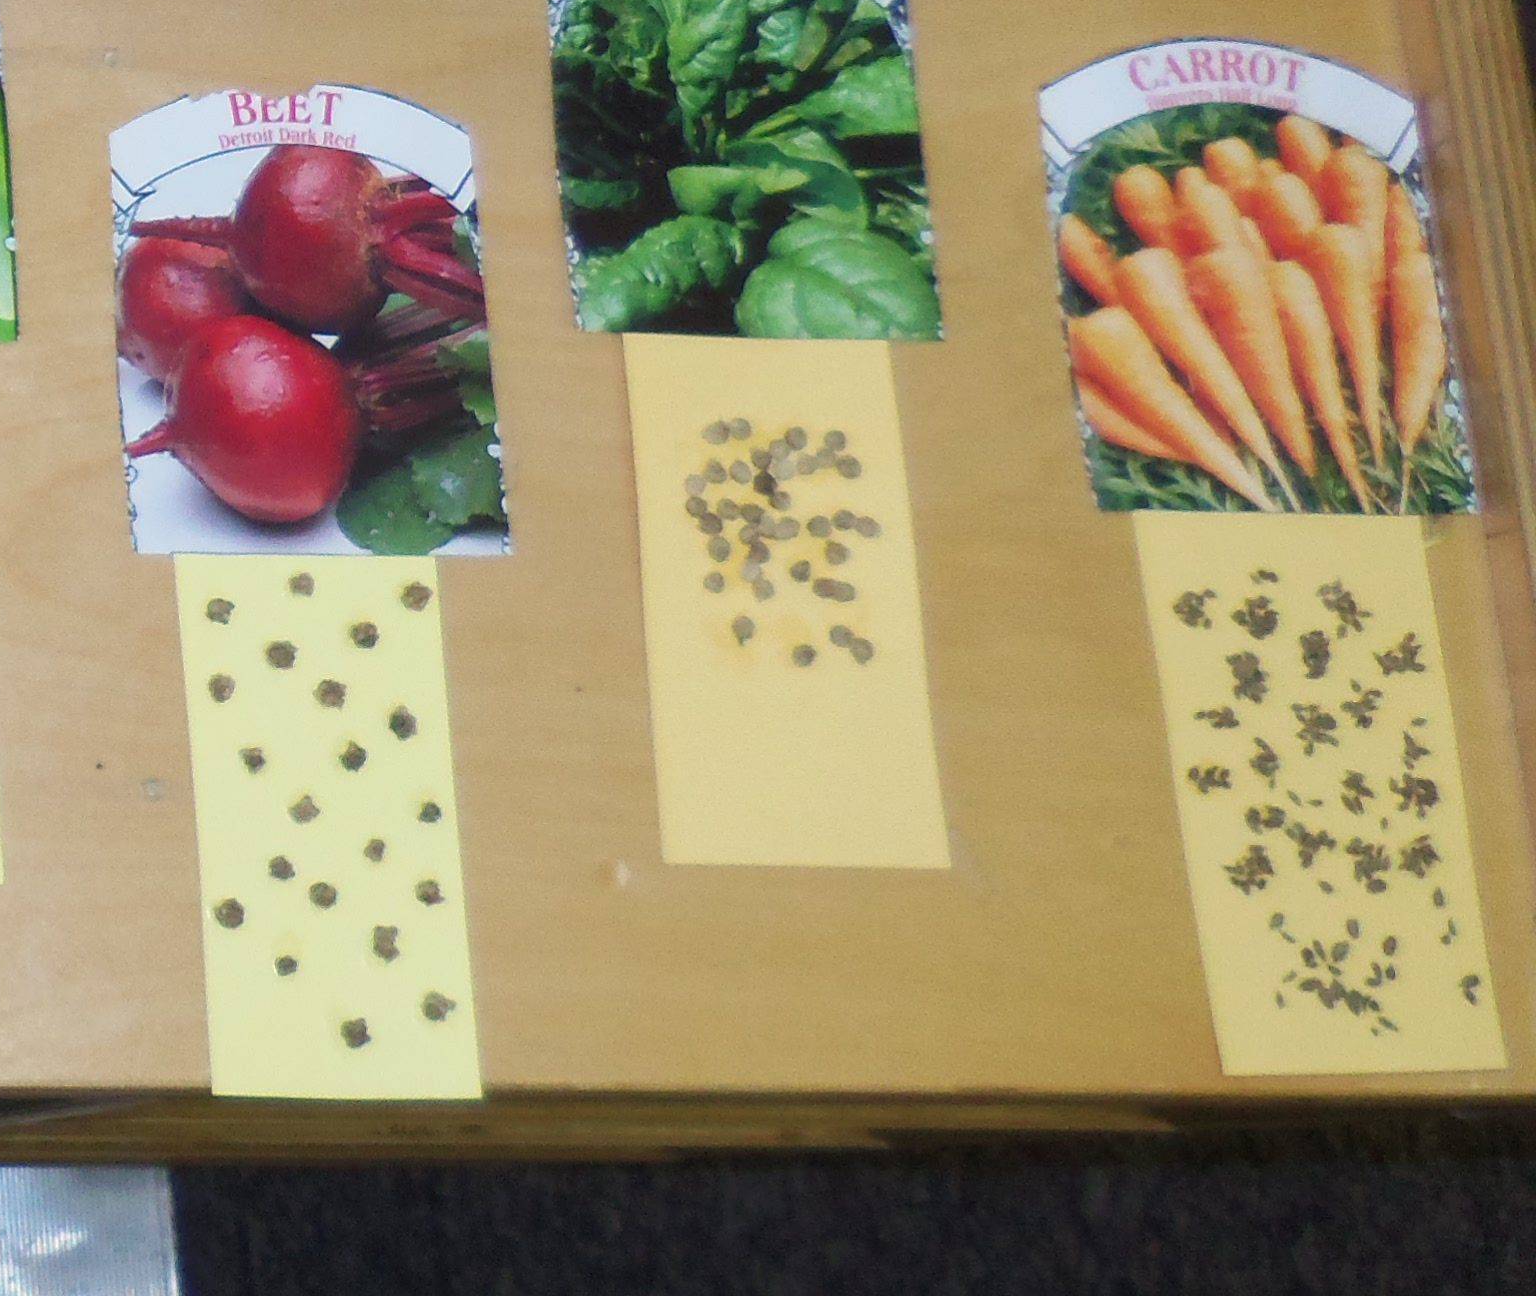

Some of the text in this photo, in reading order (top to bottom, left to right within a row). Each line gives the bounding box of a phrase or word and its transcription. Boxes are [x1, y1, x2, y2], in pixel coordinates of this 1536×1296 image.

[1127, 47, 1307, 93] CARROT
[228, 89, 343, 127] BEET
[218, 127, 357, 150] Detroit Dark Red
